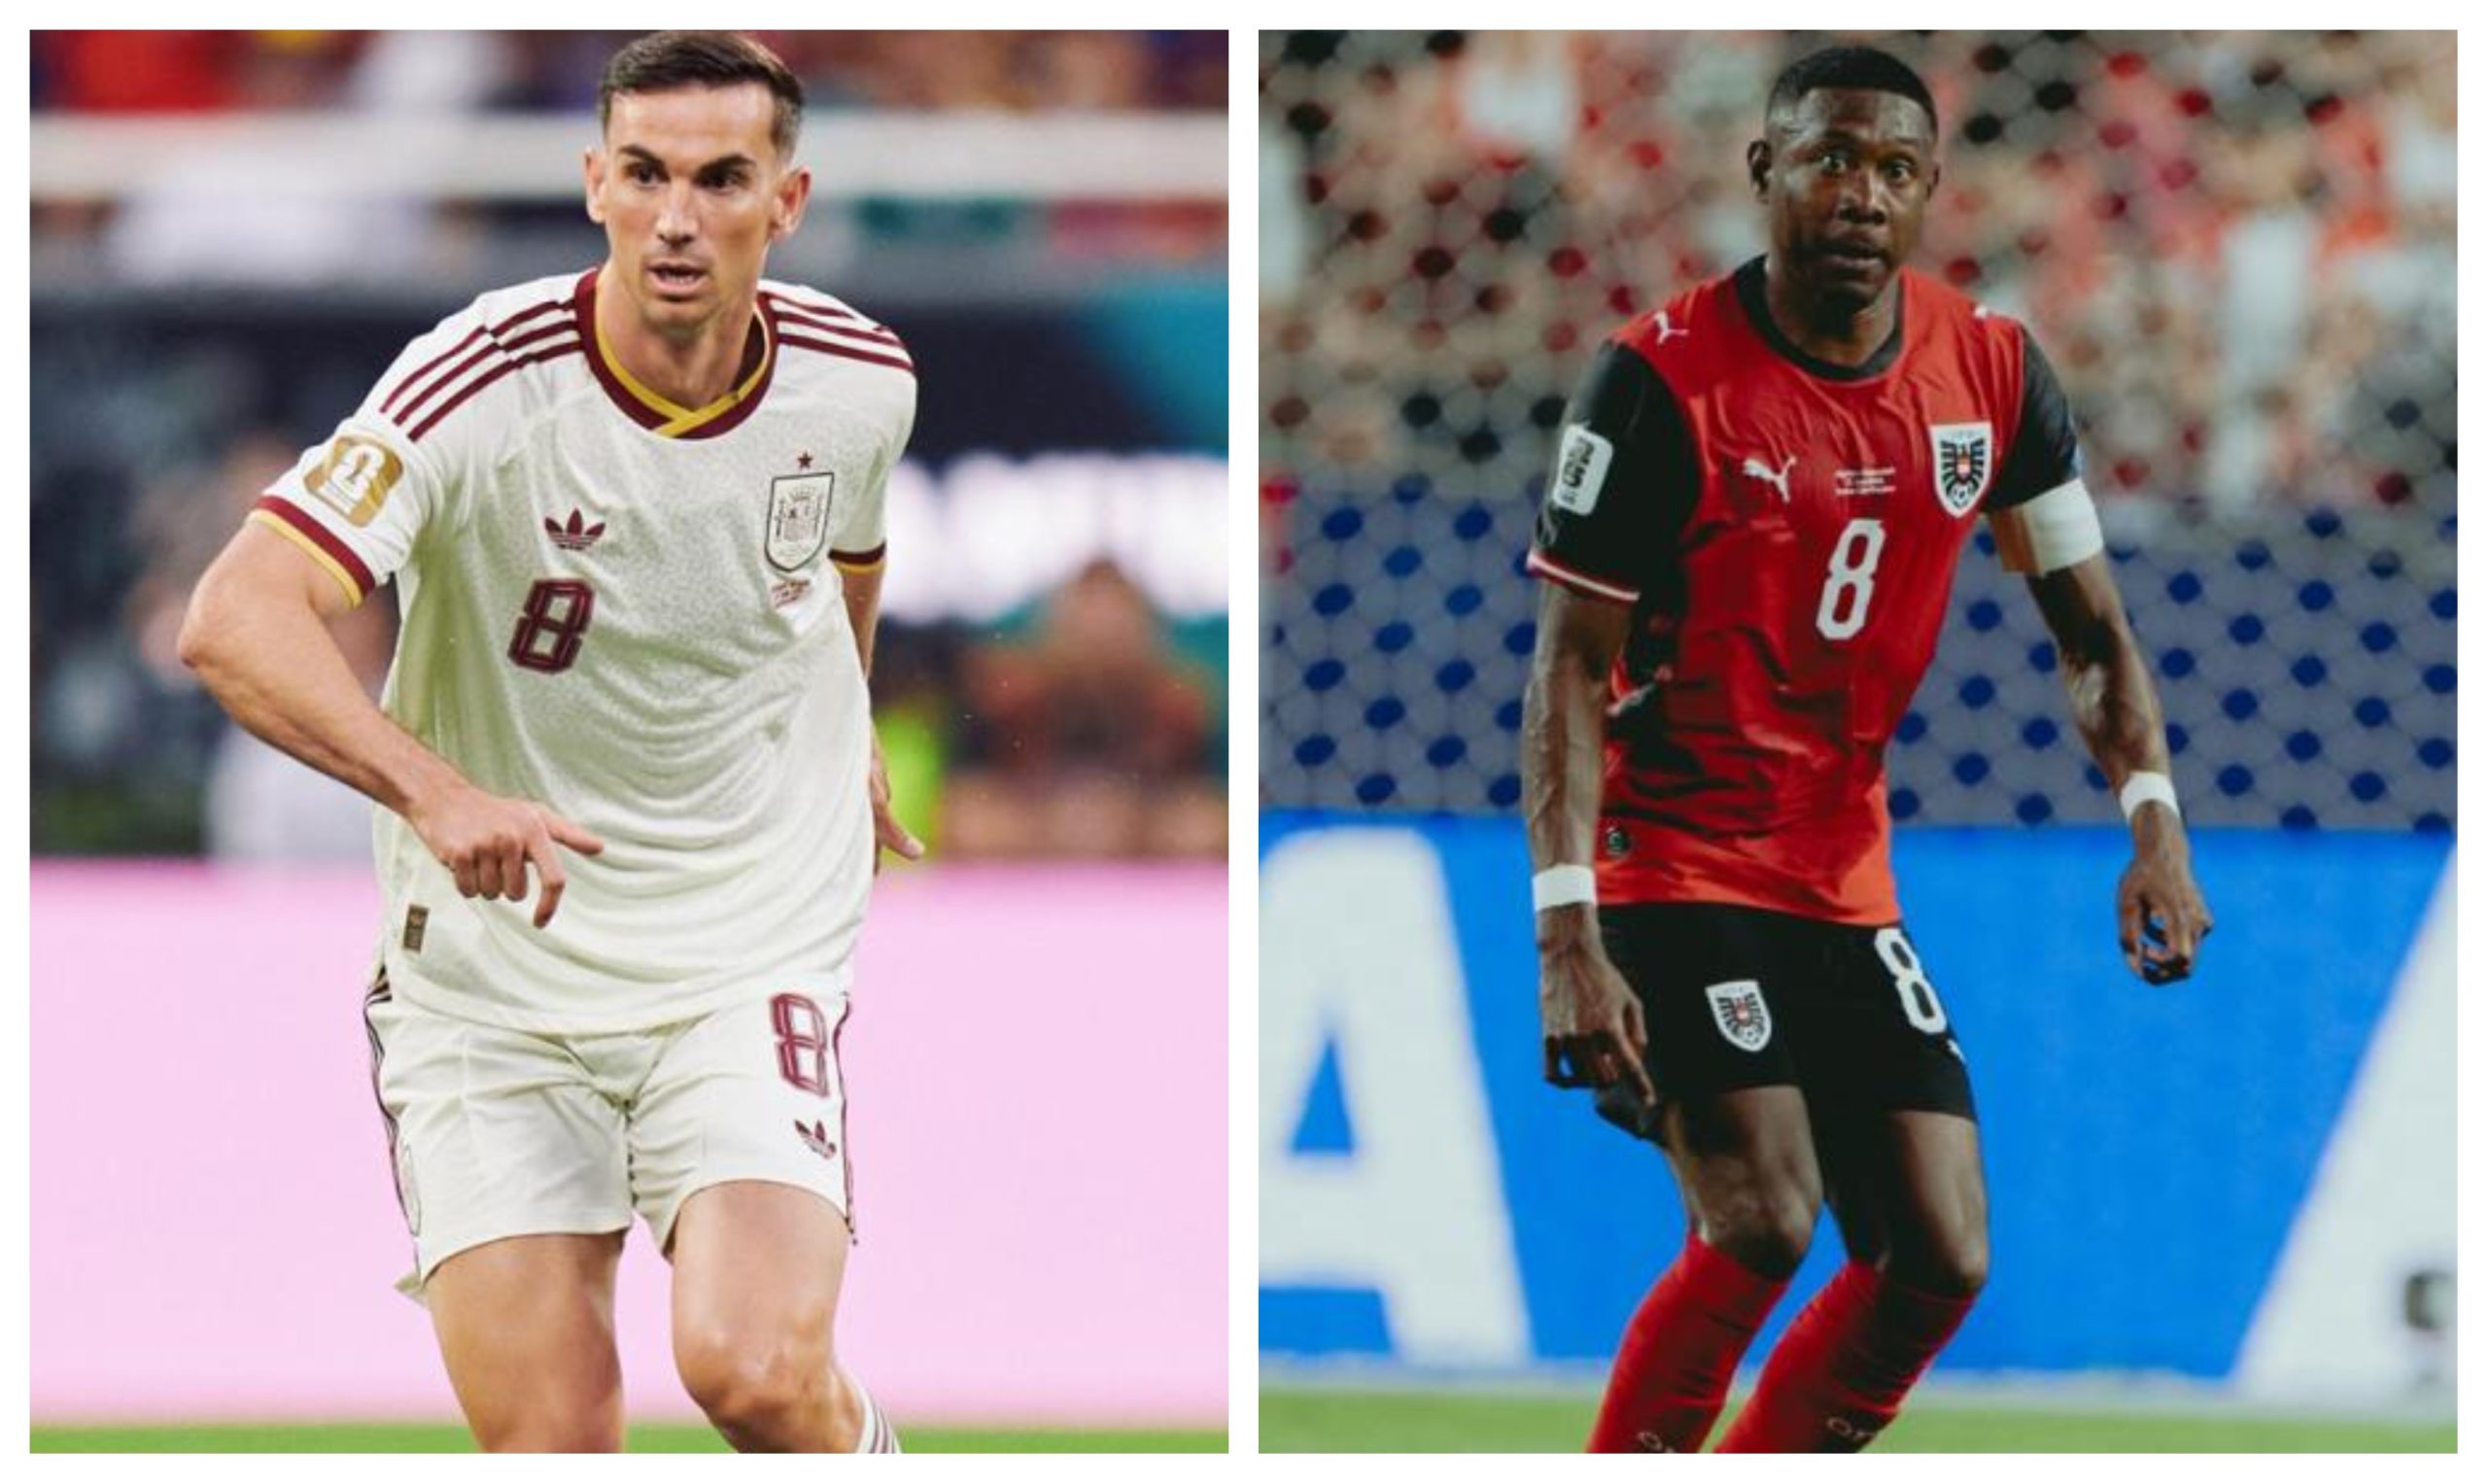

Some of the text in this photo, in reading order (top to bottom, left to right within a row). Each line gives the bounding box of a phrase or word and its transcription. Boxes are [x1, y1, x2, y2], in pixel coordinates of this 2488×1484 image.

[507, 579, 595, 674] 8
[1815, 518, 1886, 640] 8
[1875, 928, 1947, 1035] 8
[770, 993, 829, 1098] 8
